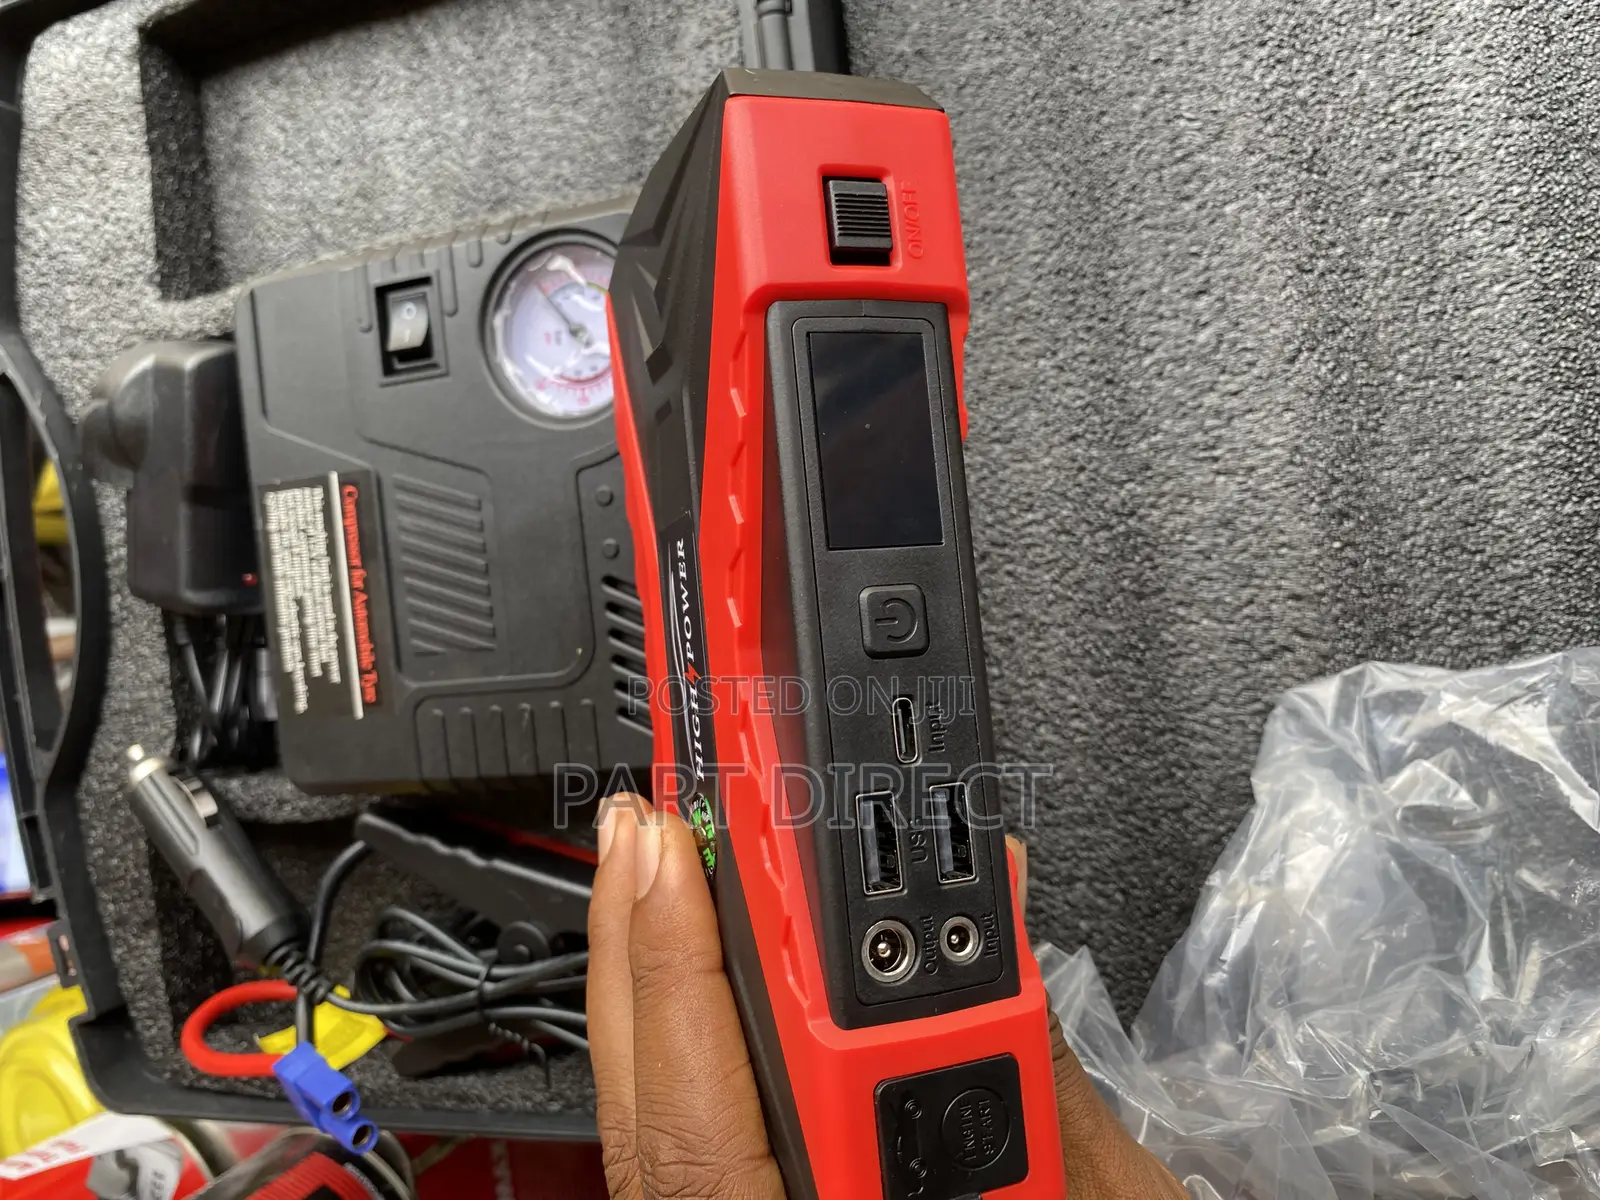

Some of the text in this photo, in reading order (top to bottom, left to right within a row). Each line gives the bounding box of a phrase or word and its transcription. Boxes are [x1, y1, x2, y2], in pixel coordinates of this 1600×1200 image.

[901, 181, 924, 259] ON/OFF
[342, 485, 361, 566] Compressor
[351, 568, 367, 591] for
[676, 537, 695, 663] POWER
[353, 591, 375, 670] Automobile
[688, 685, 704, 782] HIGH
[926, 700, 947, 753] Input
[920, 913, 939, 976] Output
[980, 912, 999, 958] Input
[979, 1100, 996, 1156] START
